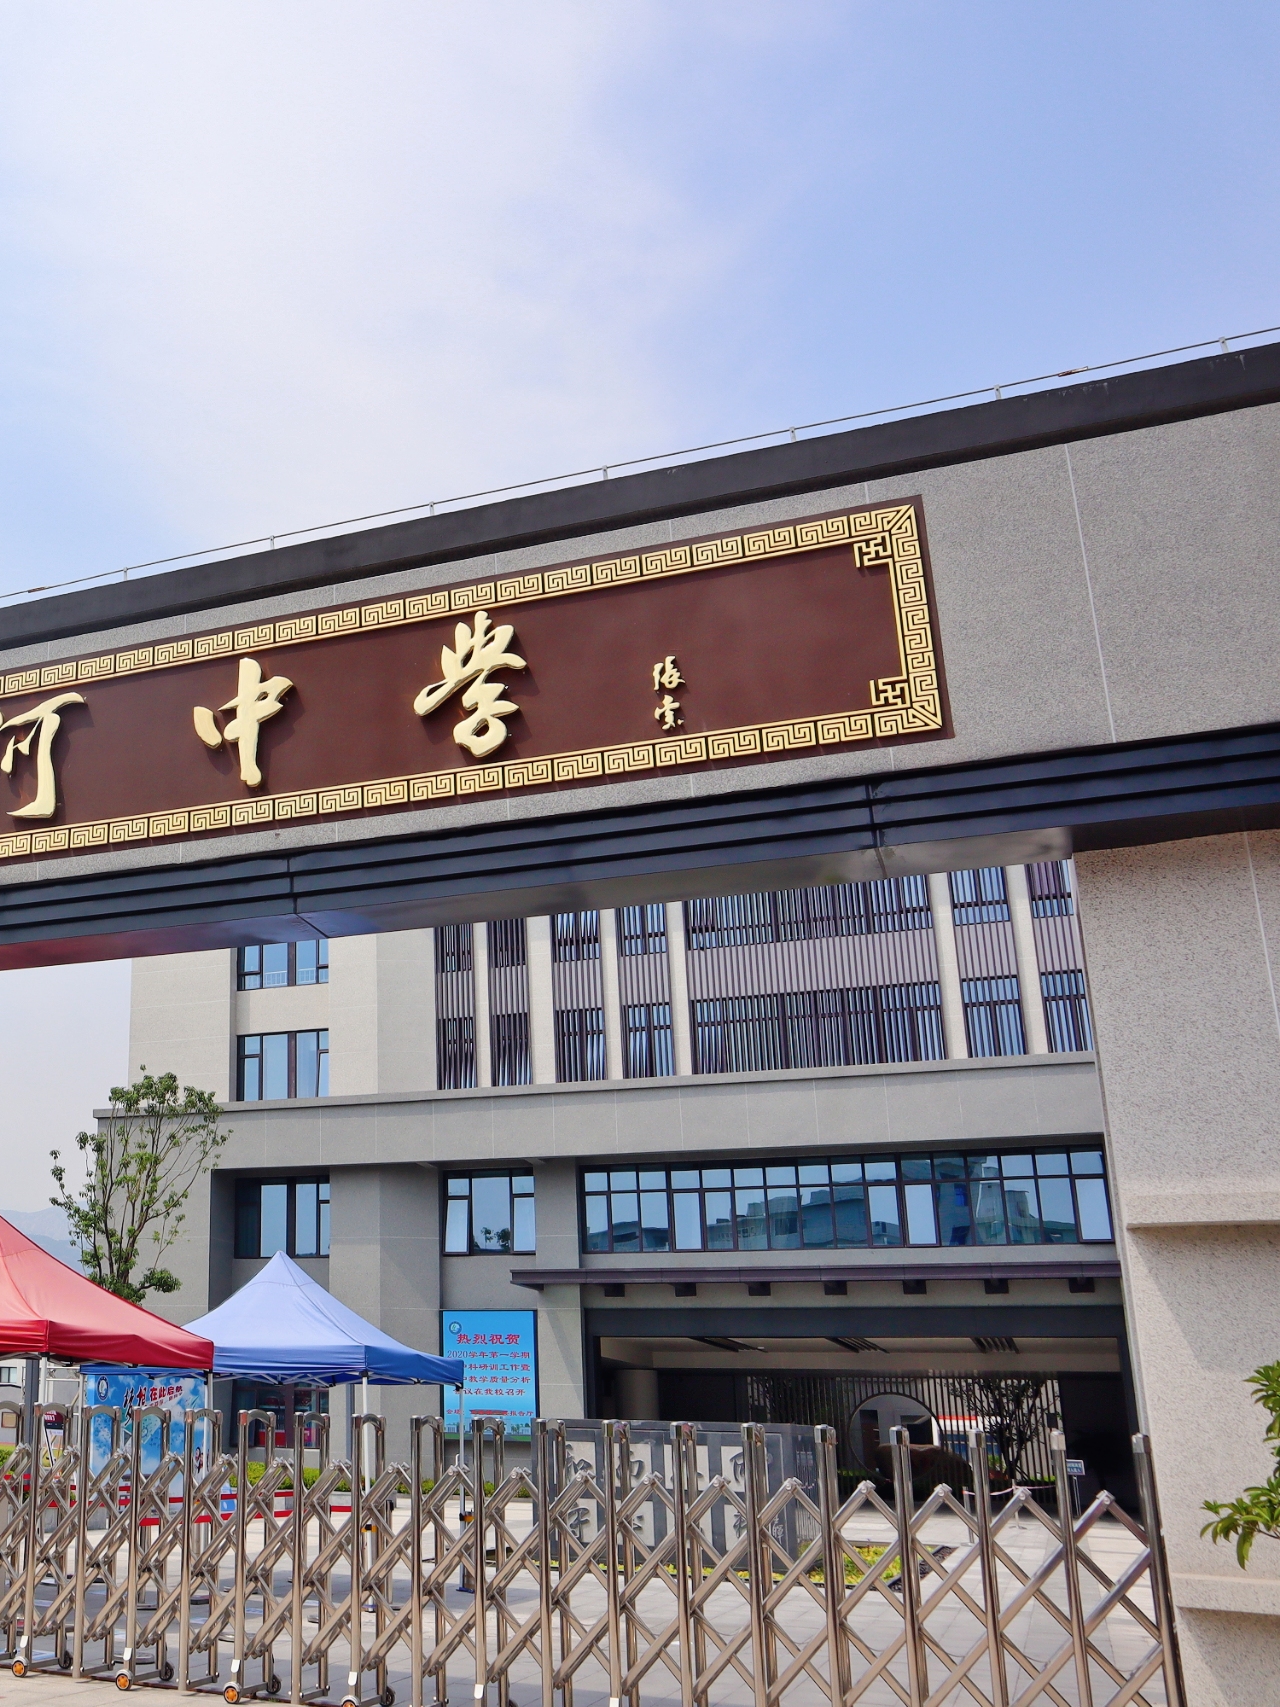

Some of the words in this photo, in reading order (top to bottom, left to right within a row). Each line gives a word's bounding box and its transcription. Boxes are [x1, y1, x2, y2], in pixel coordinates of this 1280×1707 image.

[456, 1333, 520, 1345] 热烈祝贺
[447, 1350, 531, 1359] 2020学年第一学期
[463, 1363, 531, 1372] 科研训工作暨
[463, 1375, 531, 1384] 教学质量分析
